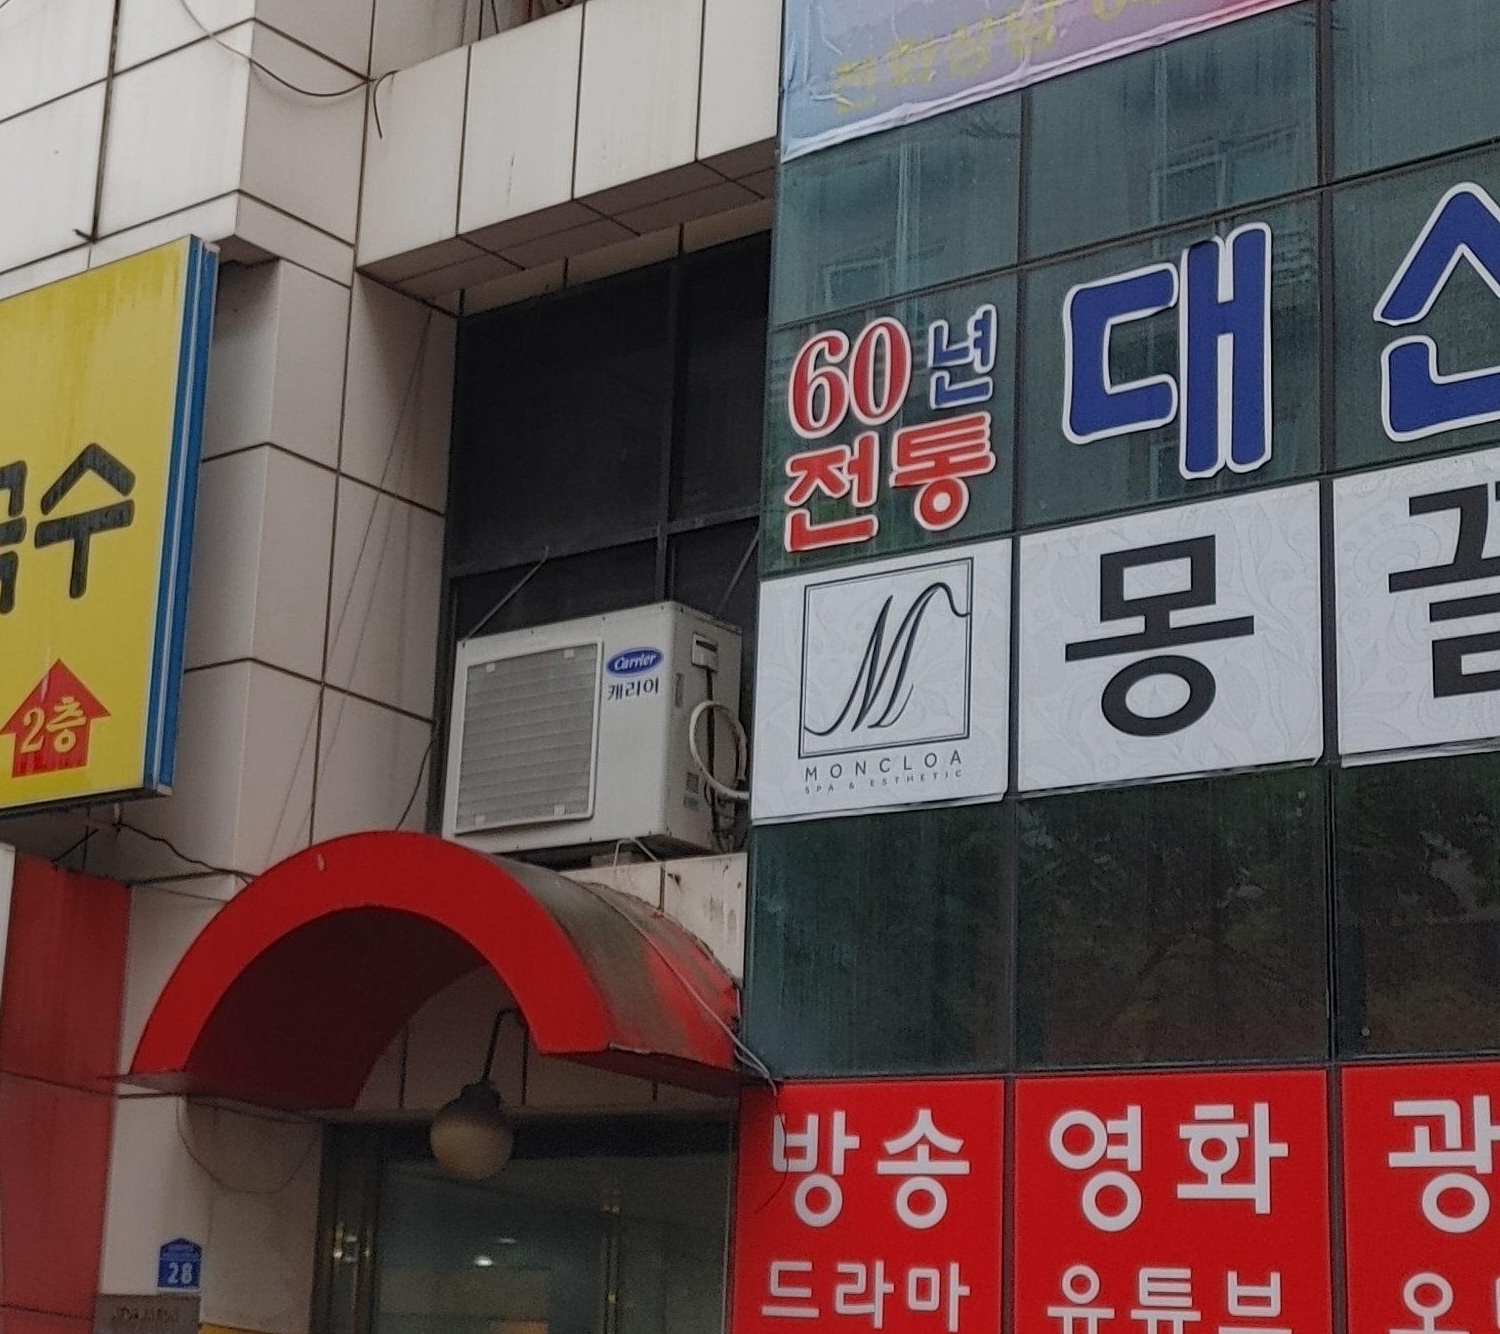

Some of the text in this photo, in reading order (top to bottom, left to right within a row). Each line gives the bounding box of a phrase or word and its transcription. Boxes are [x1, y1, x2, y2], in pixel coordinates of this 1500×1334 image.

[786, 303, 998, 441] 60년
[784, 411, 997, 554] 전통
[613, 651, 658, 672] Carrier
[20, 696, 88, 756] 2층
[805, 750, 962, 782] MONCLOA
[805, 785, 834, 795] SPA
[870, 769, 963, 788] ESTHETIC
[772, 1108, 971, 1230] 방송
[1048, 1100, 1290, 1233] 영화
[167, 1262, 194, 1285] 28
[761, 1259, 971, 1333] 드라마
